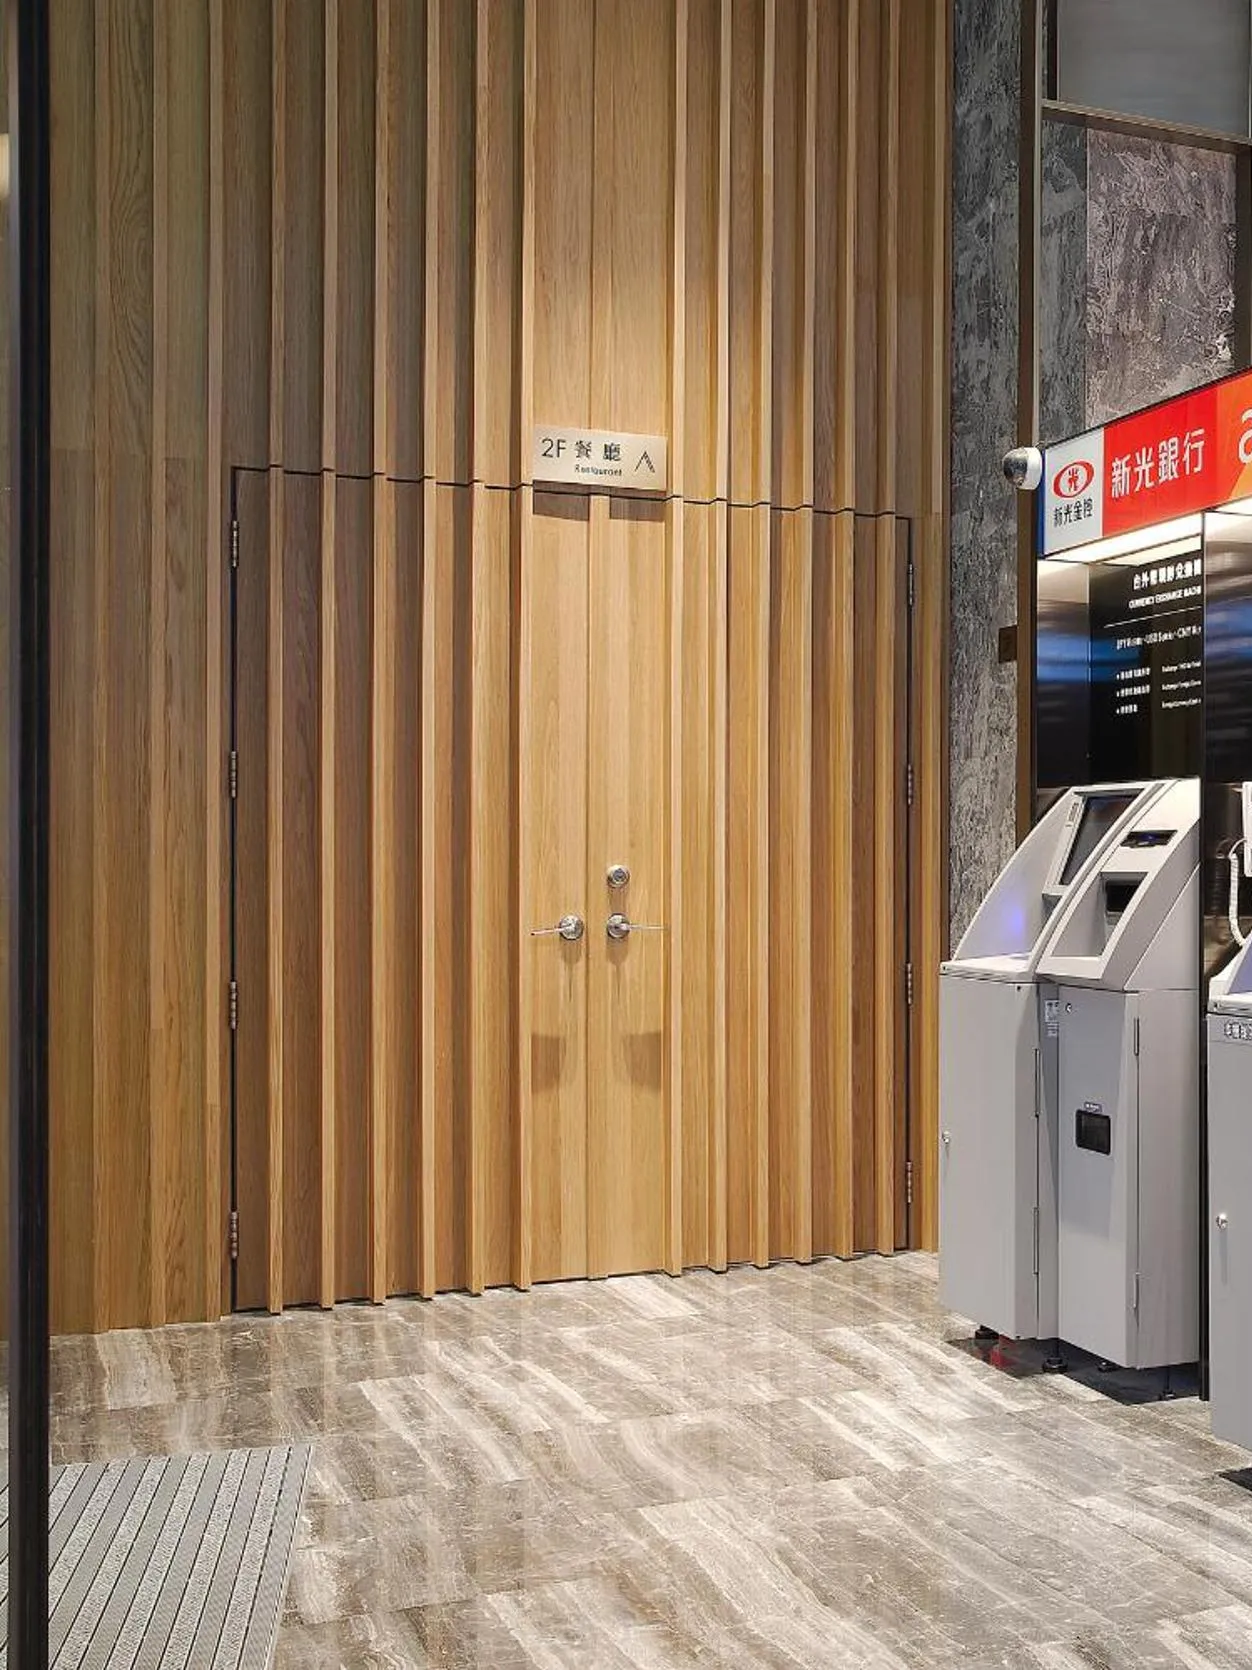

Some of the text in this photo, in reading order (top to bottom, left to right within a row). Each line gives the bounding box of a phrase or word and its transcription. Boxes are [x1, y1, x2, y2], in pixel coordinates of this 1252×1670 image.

[541, 438, 566, 458] 2F
[1111, 428, 1204, 498] 新光銀行
[1054, 498, 1093, 527] 新光金控
